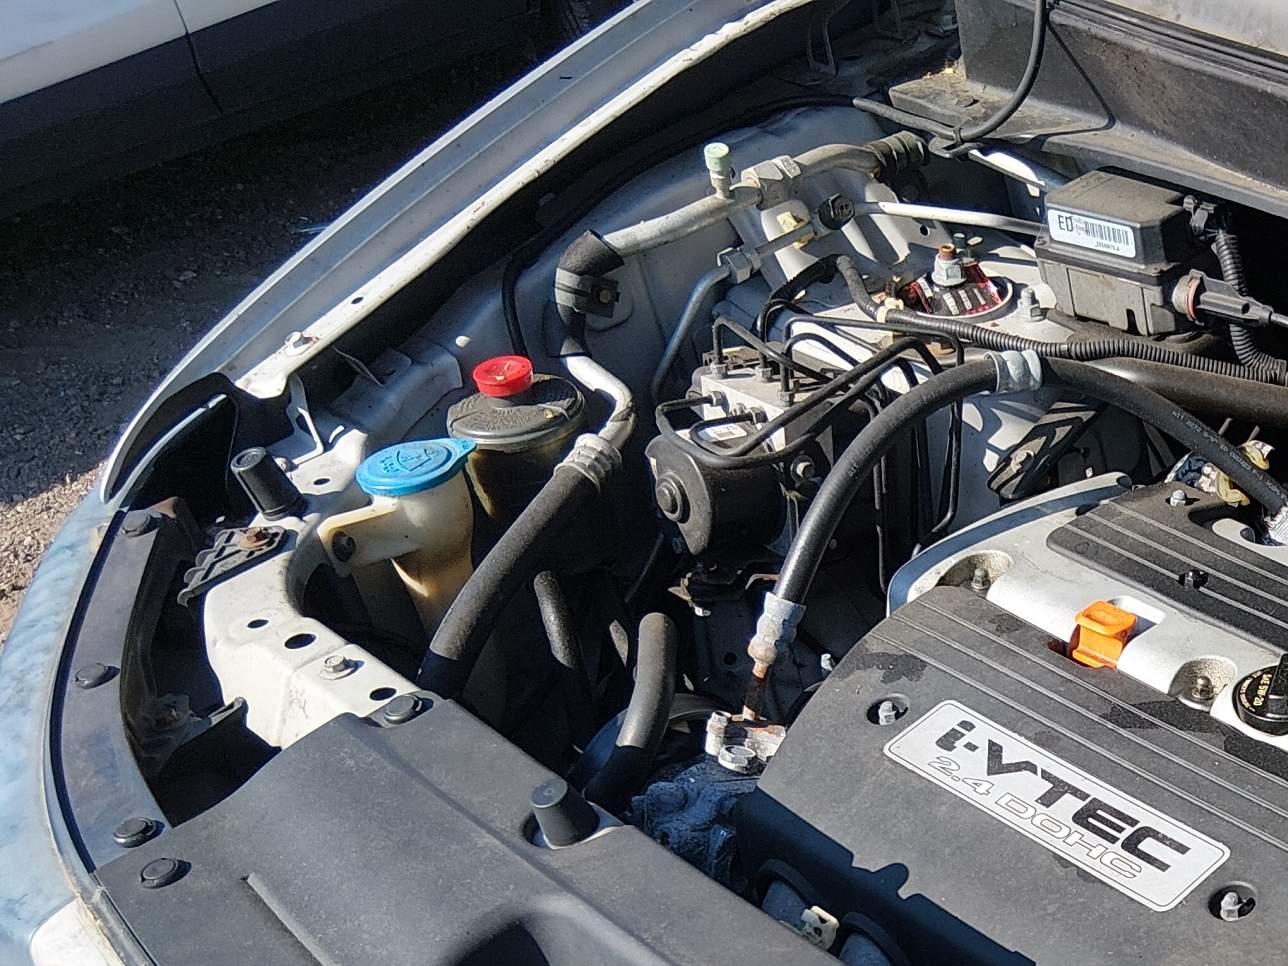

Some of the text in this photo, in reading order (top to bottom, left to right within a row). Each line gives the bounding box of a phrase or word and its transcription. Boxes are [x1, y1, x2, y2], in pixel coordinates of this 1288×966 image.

[1058, 214, 1074, 232] ED
[927, 755, 1143, 879] 2.4 DOHC
[935, 720, 1191, 872] i-VTEC
